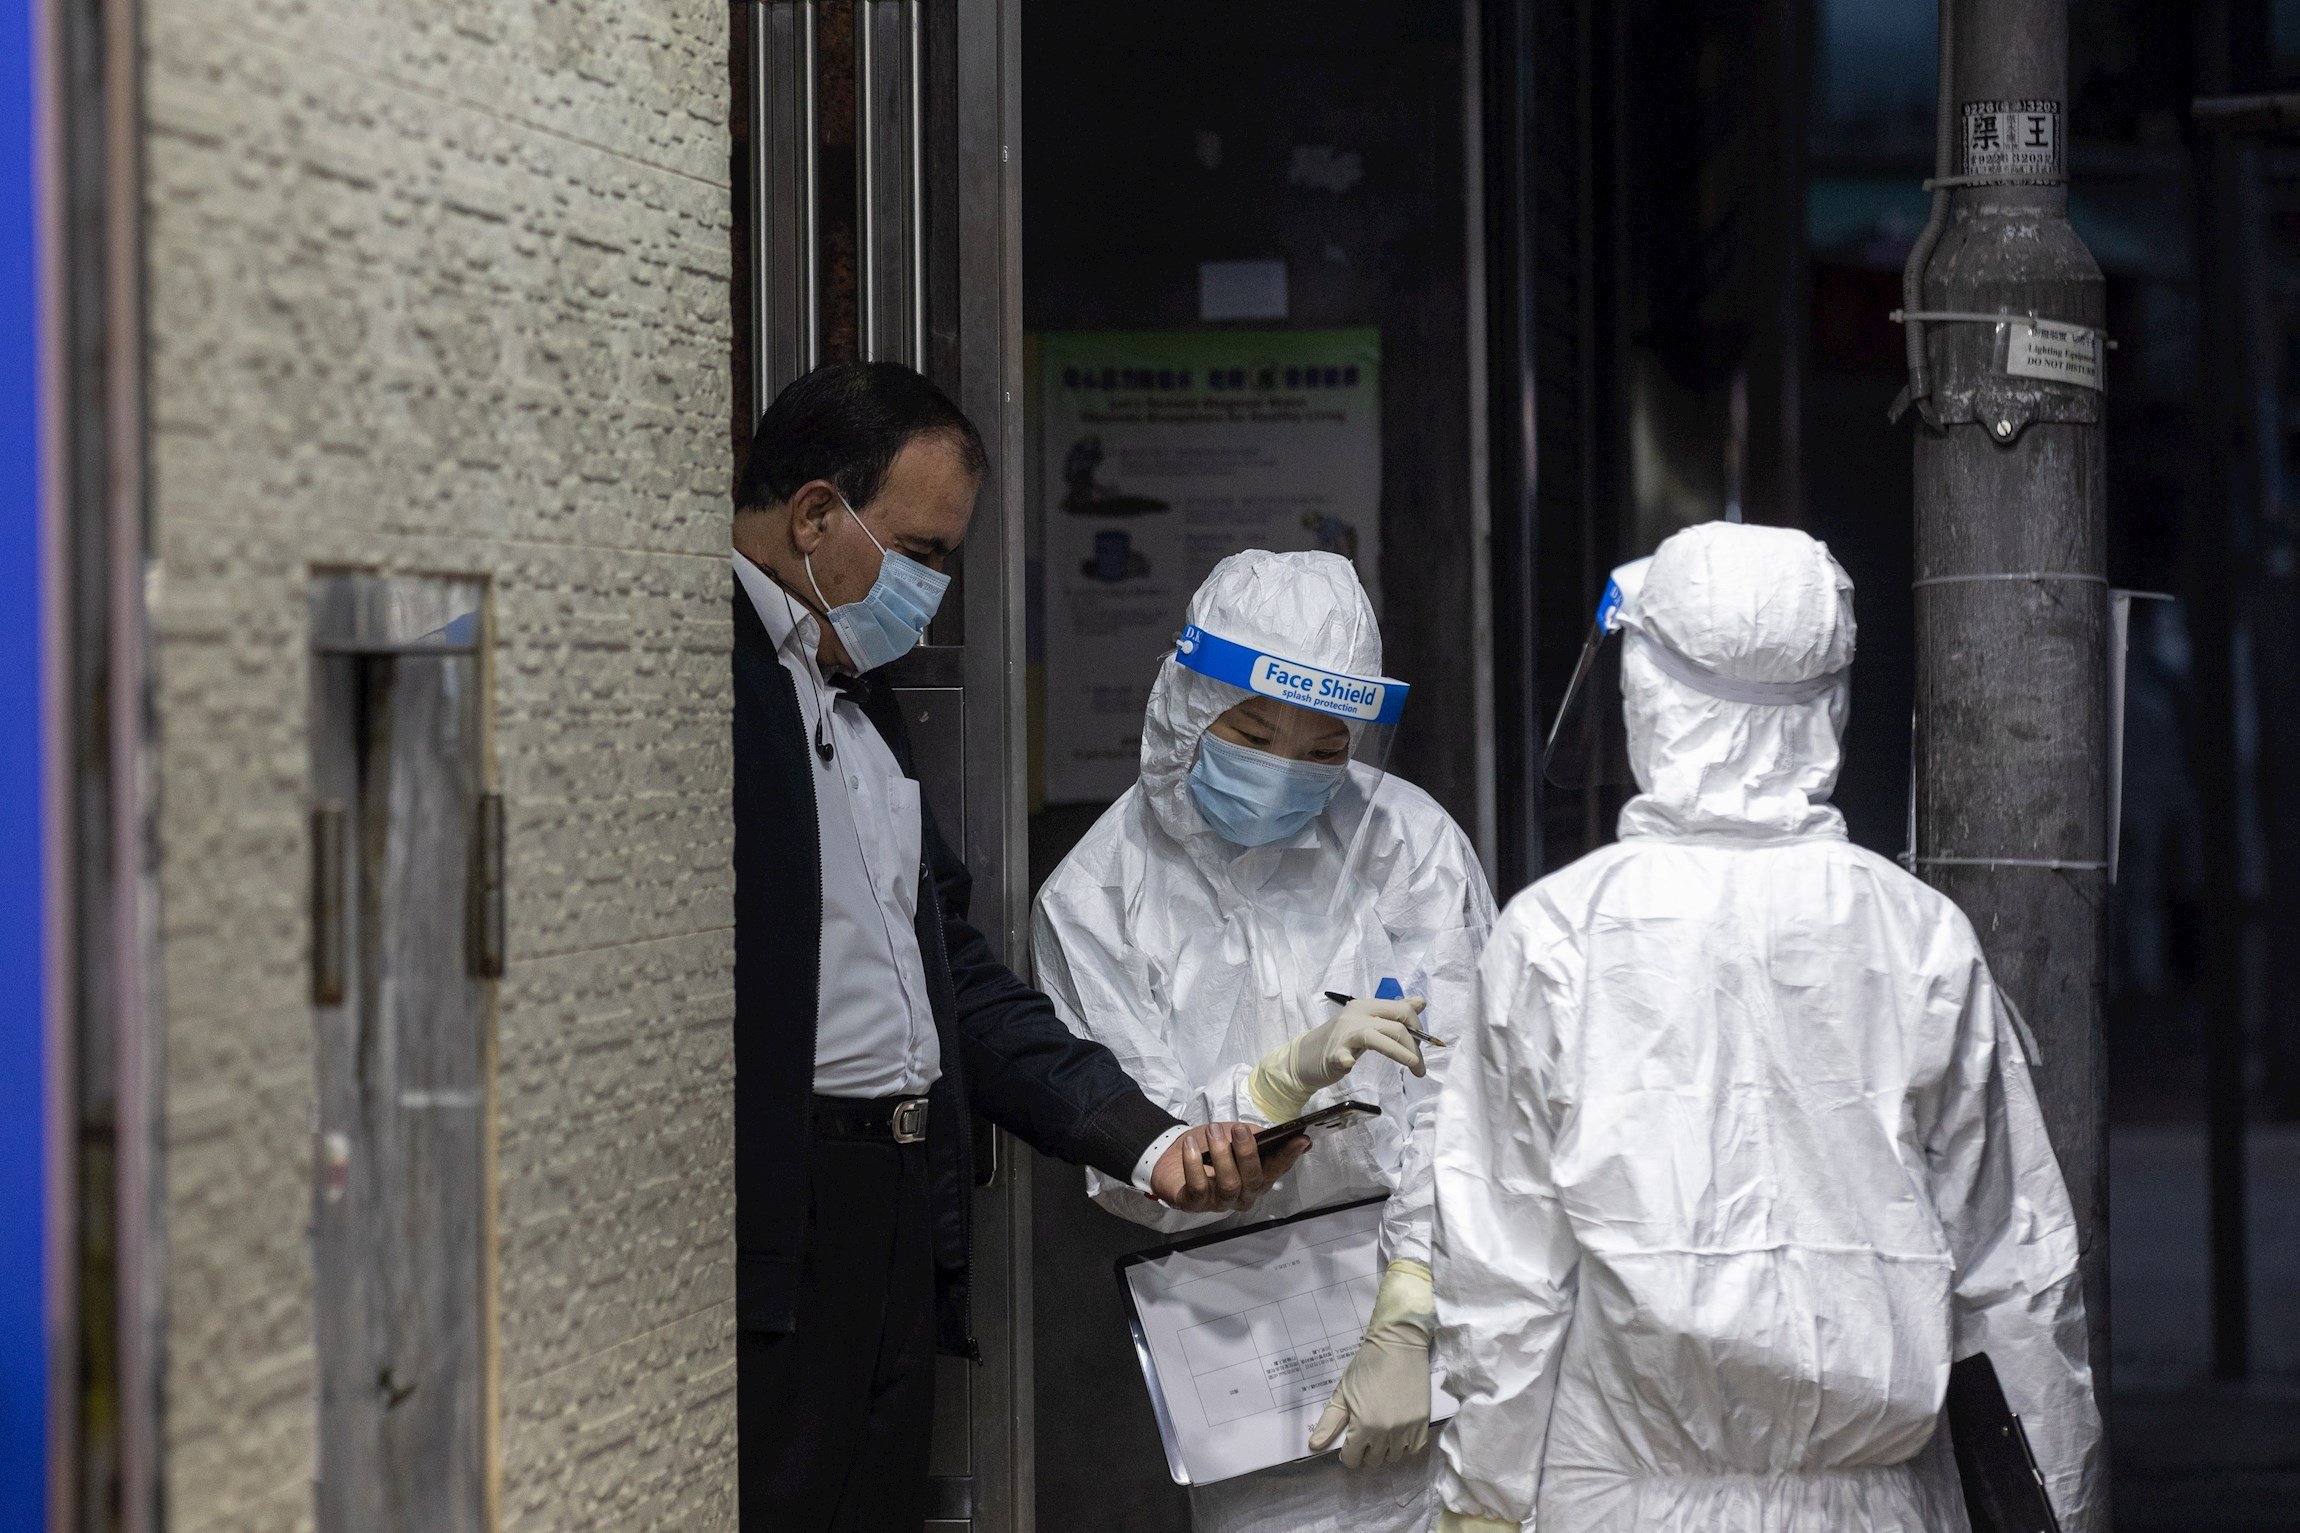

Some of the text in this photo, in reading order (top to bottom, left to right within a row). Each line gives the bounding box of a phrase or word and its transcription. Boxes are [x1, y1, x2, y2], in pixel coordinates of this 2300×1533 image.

[2025, 116, 2048, 147] 王
[2027, 356, 2042, 366] DO
[2044, 358, 2064, 369] NOT
[2028, 343, 2063, 358] Lighting
[1265, 662, 1377, 706] Face Shield
[1282, 688, 1358, 714] splash protection
